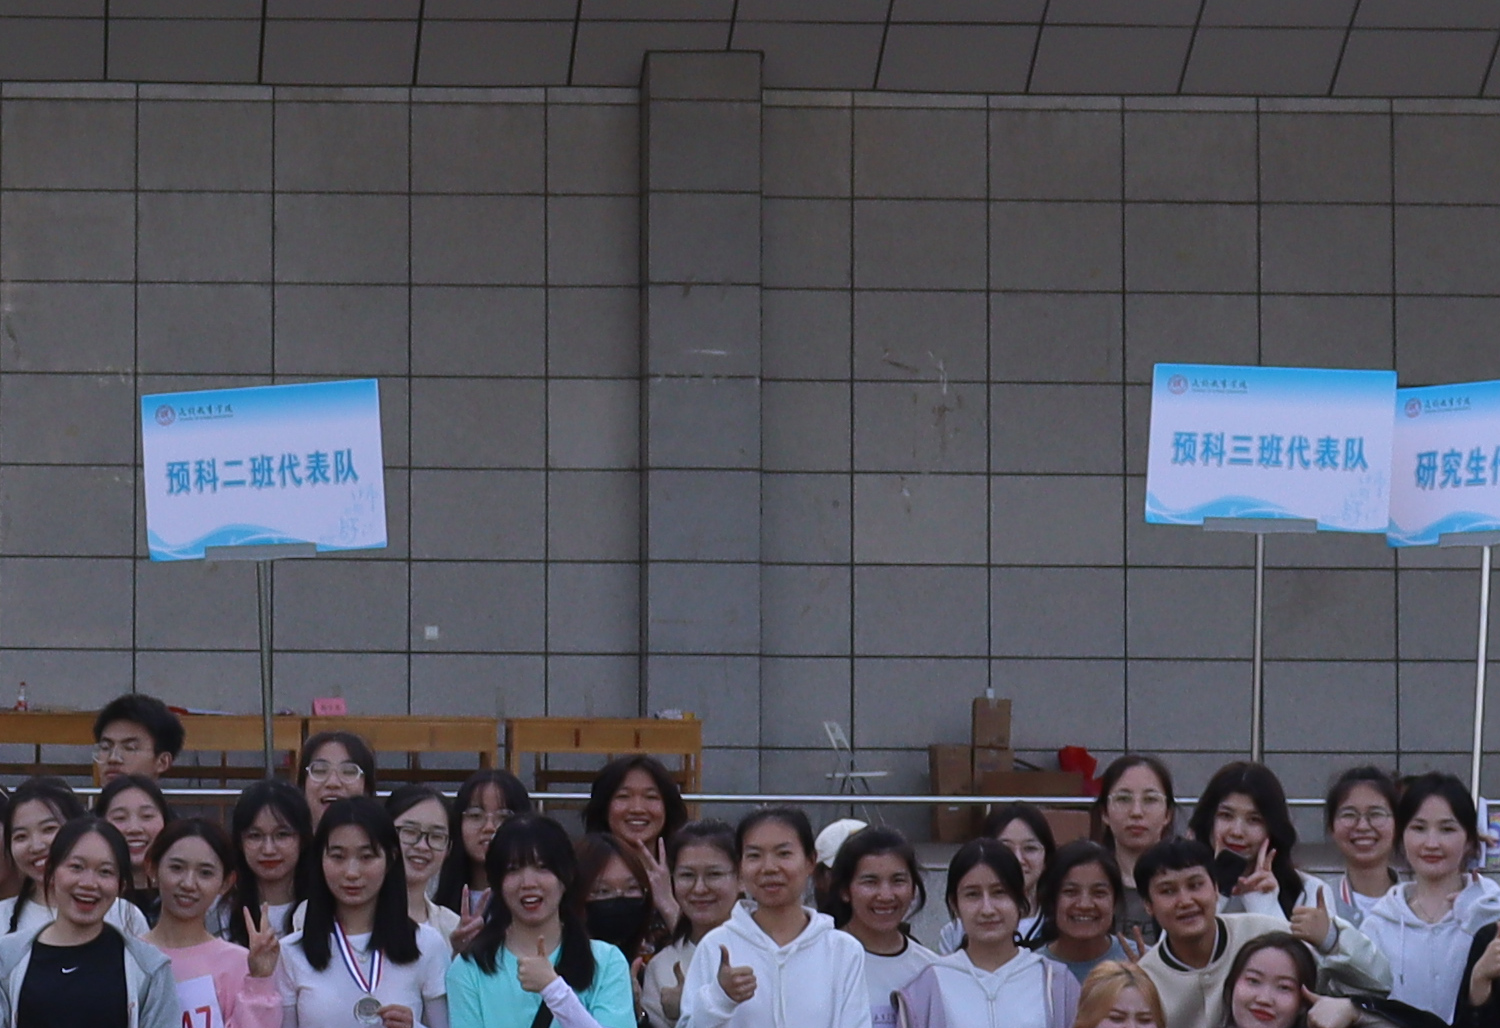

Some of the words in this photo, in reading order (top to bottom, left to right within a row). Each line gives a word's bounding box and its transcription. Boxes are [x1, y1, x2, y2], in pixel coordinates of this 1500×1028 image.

[166, 448, 359, 495] 预科二班代表队
[1171, 431, 1369, 471] 预科三班代表队
